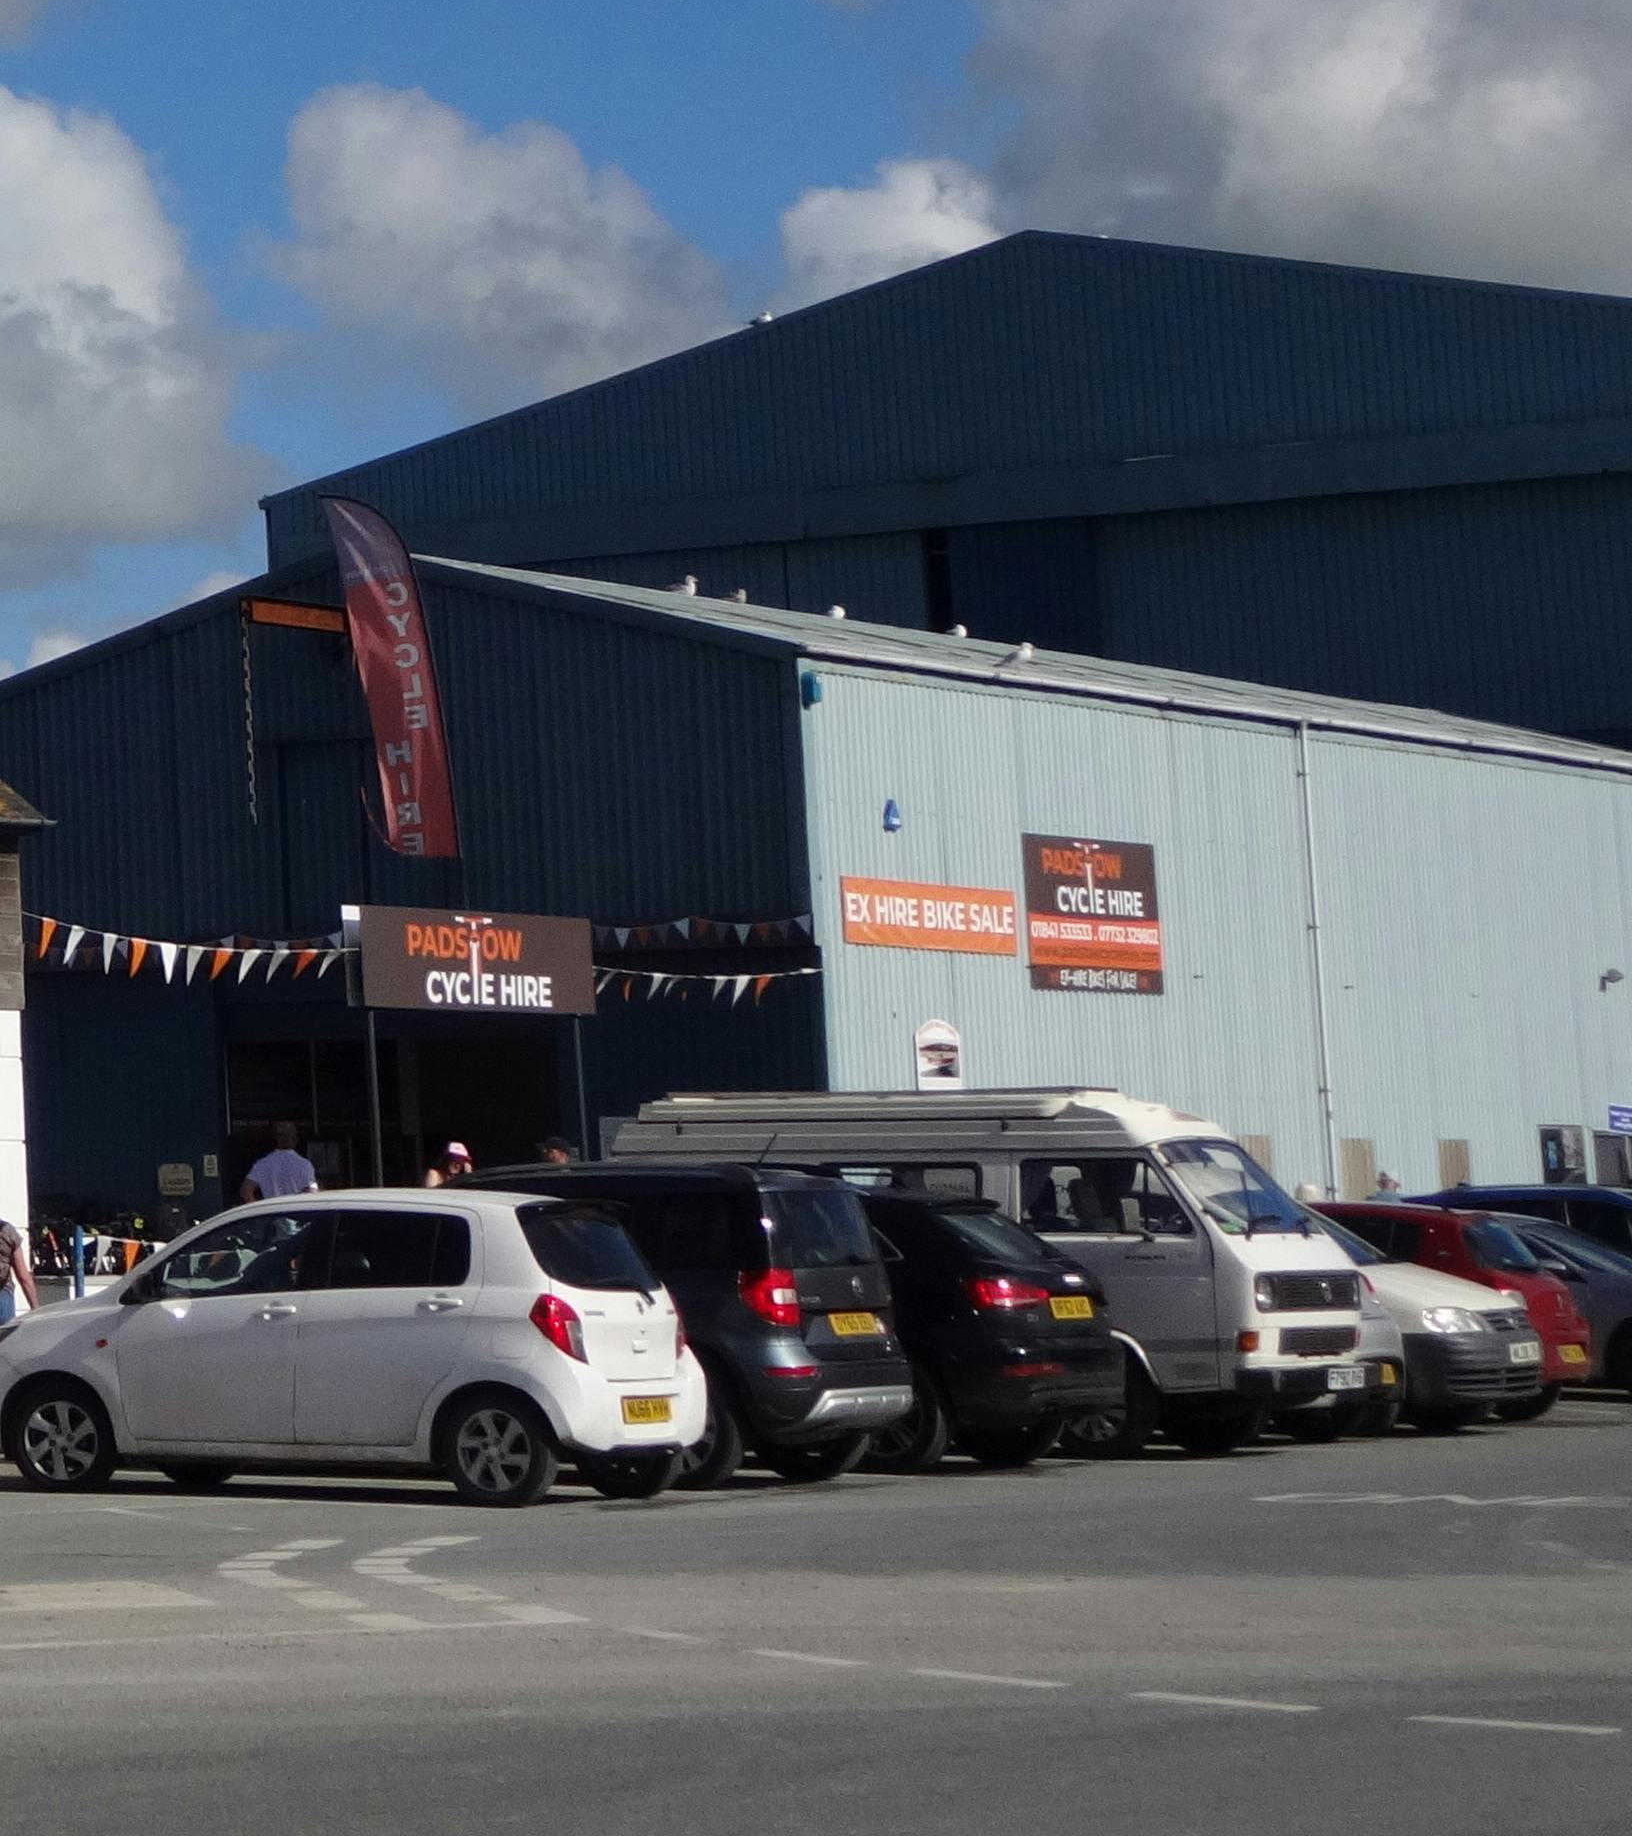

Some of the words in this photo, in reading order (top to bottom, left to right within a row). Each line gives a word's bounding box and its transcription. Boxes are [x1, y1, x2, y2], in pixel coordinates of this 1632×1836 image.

[846, 893, 871, 922] EX
[875, 896, 918, 928] HIRE
[923, 900, 966, 931] BIKE
[969, 904, 1013, 934] SALE
[1109, 889, 1143, 917] HIRE
[500, 975, 552, 1007] HIRE
